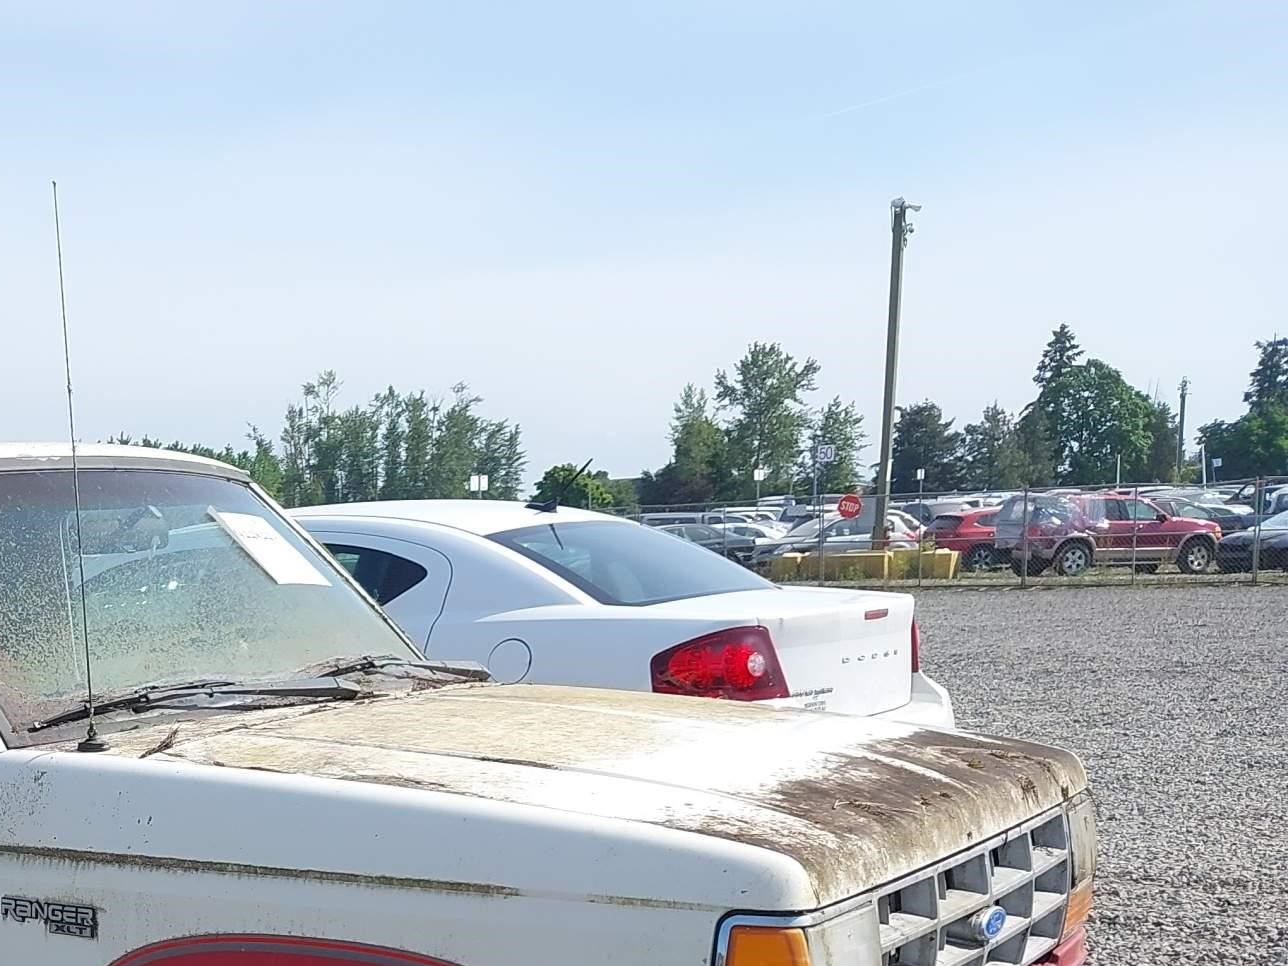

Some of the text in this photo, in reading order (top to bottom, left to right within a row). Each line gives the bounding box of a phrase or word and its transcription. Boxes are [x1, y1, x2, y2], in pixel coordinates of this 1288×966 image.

[819, 446, 833, 460] 50
[839, 500, 860, 513] STOP
[1, 897, 96, 926] RANGER
[52, 923, 89, 935] XLT
